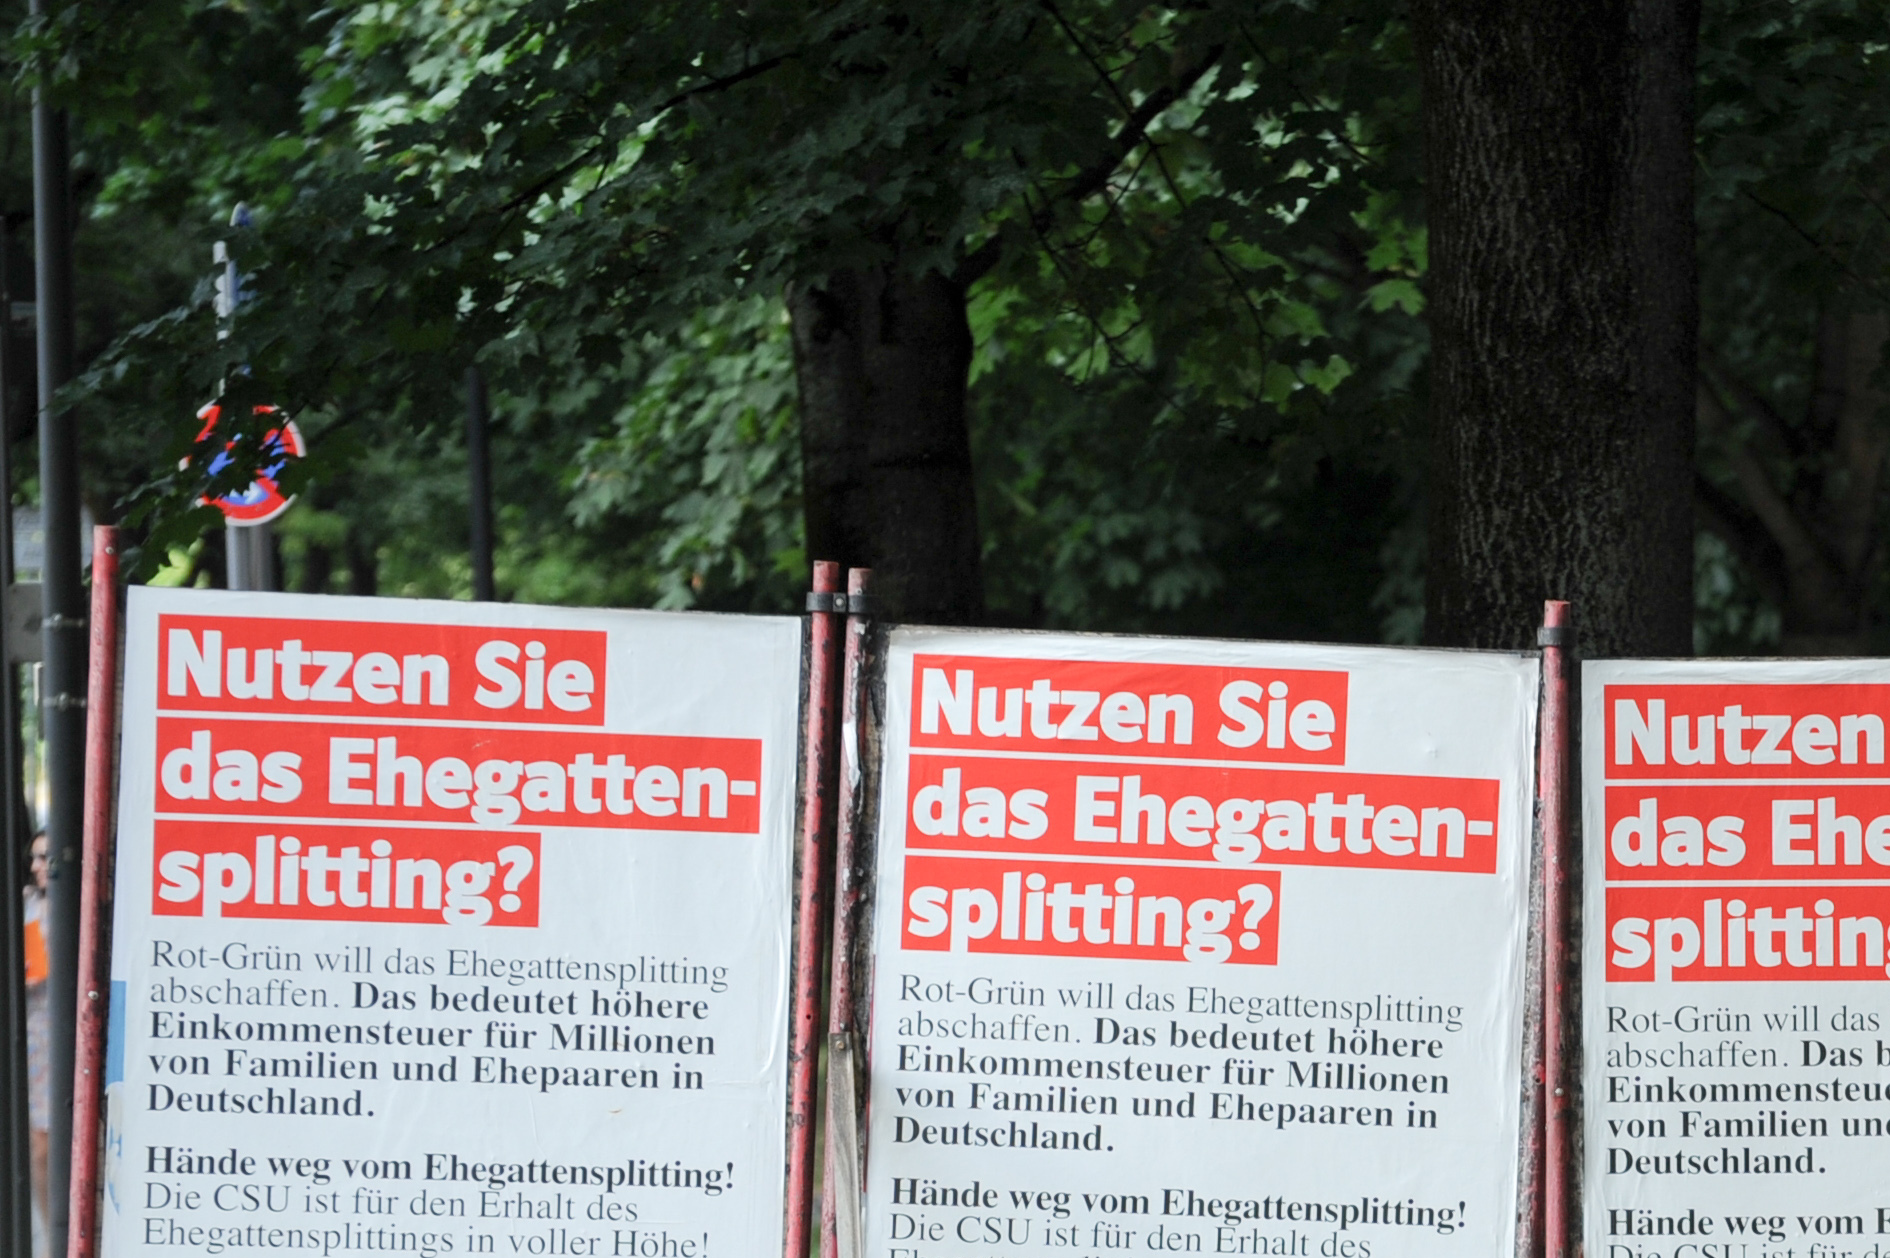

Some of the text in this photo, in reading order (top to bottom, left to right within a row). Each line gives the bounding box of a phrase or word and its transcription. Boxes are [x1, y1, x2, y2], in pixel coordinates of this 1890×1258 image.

[169, 627, 595, 712] Nutzen Sie
[921, 666, 1336, 752] Nutzen Sie
[1615, 699, 1884, 765] Nutzen
[162, 729, 757, 825] das Ehegatten-
[913, 767, 1494, 864] das Ehegatten-
[1612, 798, 1746, 867] das
[159, 835, 534, 928] splitting?
[908, 871, 1274, 965] splitting?
[150, 976, 709, 1020] abschaffen. Das bedeutet höhere
[151, 940, 729, 994] Rot-Grün will das Ehegattensplitting
[145, 1083, 374, 1117] Deutschland.
[897, 1044, 1449, 1095] Einkommensteuer für Millionen
[892, 1116, 1114, 1152] Deutschland.
[896, 1082, 1438, 1131] von Familien und Ehepaaren in
[145, 1145, 734, 1197] Hände weg vom Ehegattensplitting!
